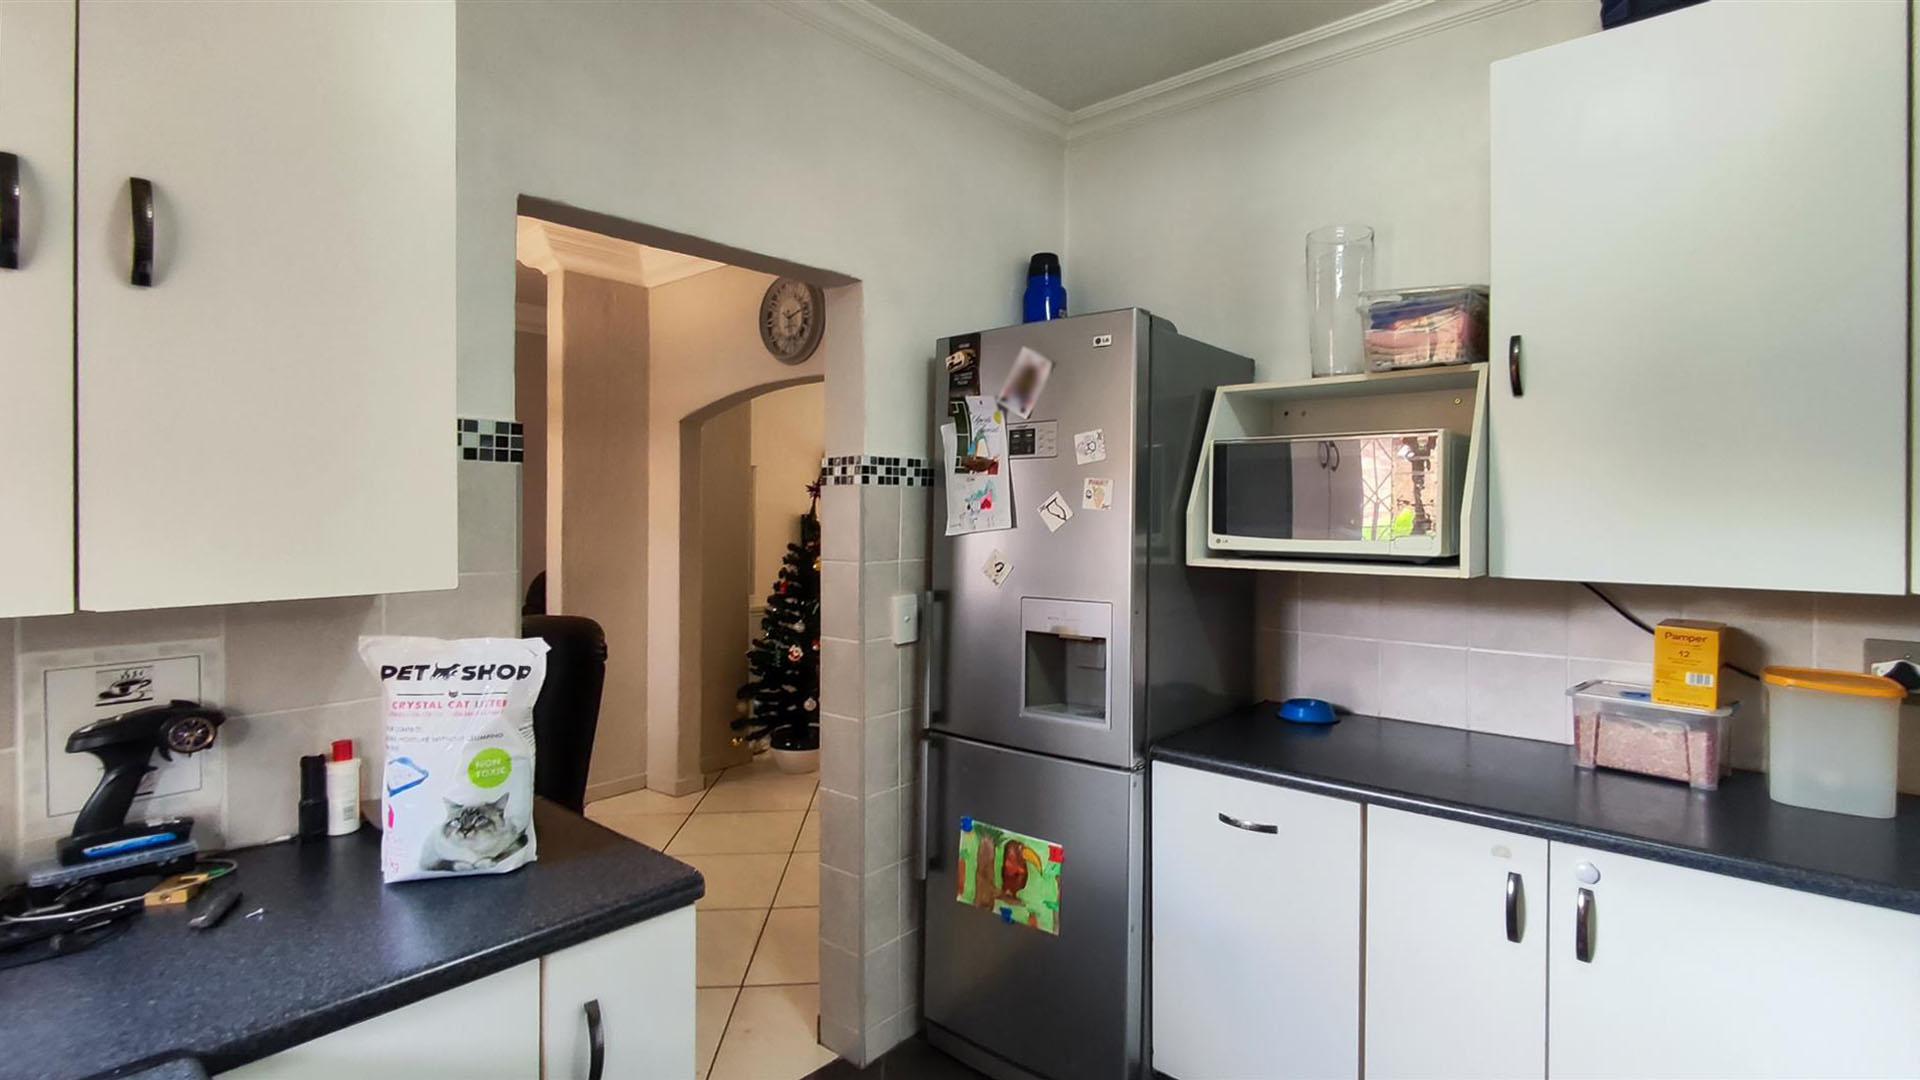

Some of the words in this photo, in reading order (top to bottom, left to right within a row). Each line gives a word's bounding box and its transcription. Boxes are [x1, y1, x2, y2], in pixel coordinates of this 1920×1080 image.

[1664, 631, 1707, 643] Pamper
[1678, 650, 1690, 658] 12
[380, 664, 430, 681] PET
[461, 664, 532, 681] SHOP
[392, 700, 443, 710] CRYSTAL
[447, 700, 469, 709] CAT
[475, 758, 502, 769] NON
[476, 766, 507, 779] TOXIC
